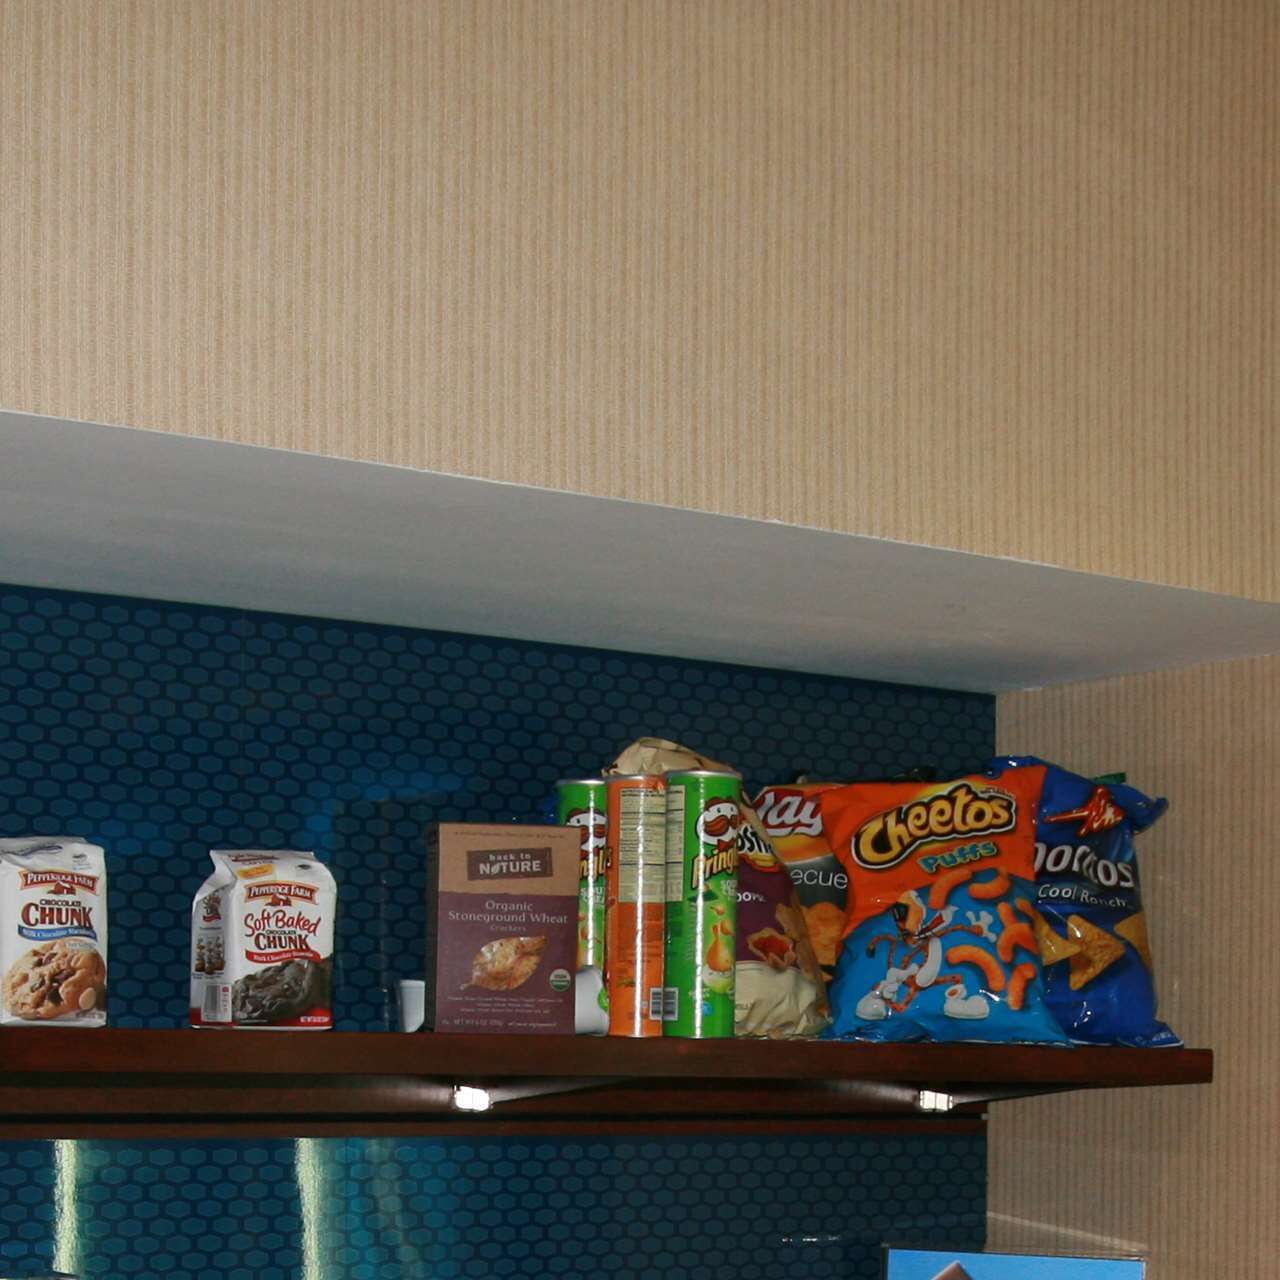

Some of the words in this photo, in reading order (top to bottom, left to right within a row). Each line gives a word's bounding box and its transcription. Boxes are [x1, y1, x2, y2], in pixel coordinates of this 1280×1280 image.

[853, 782, 1017, 868] Cheetos
[918, 841, 998, 874] Puffs
[484, 900, 533, 912] Organic
[1038, 883, 1078, 900] Cool
[1080, 889, 1128, 908] Ranch
[21, 901, 94, 929] CHUNK
[244, 909, 272, 937] Soft
[272, 909, 322, 937] Baked
[448, 910, 526, 923] Stoneground
[529, 913, 568, 924] Wheat
[254, 932, 311, 951] CHUNK
